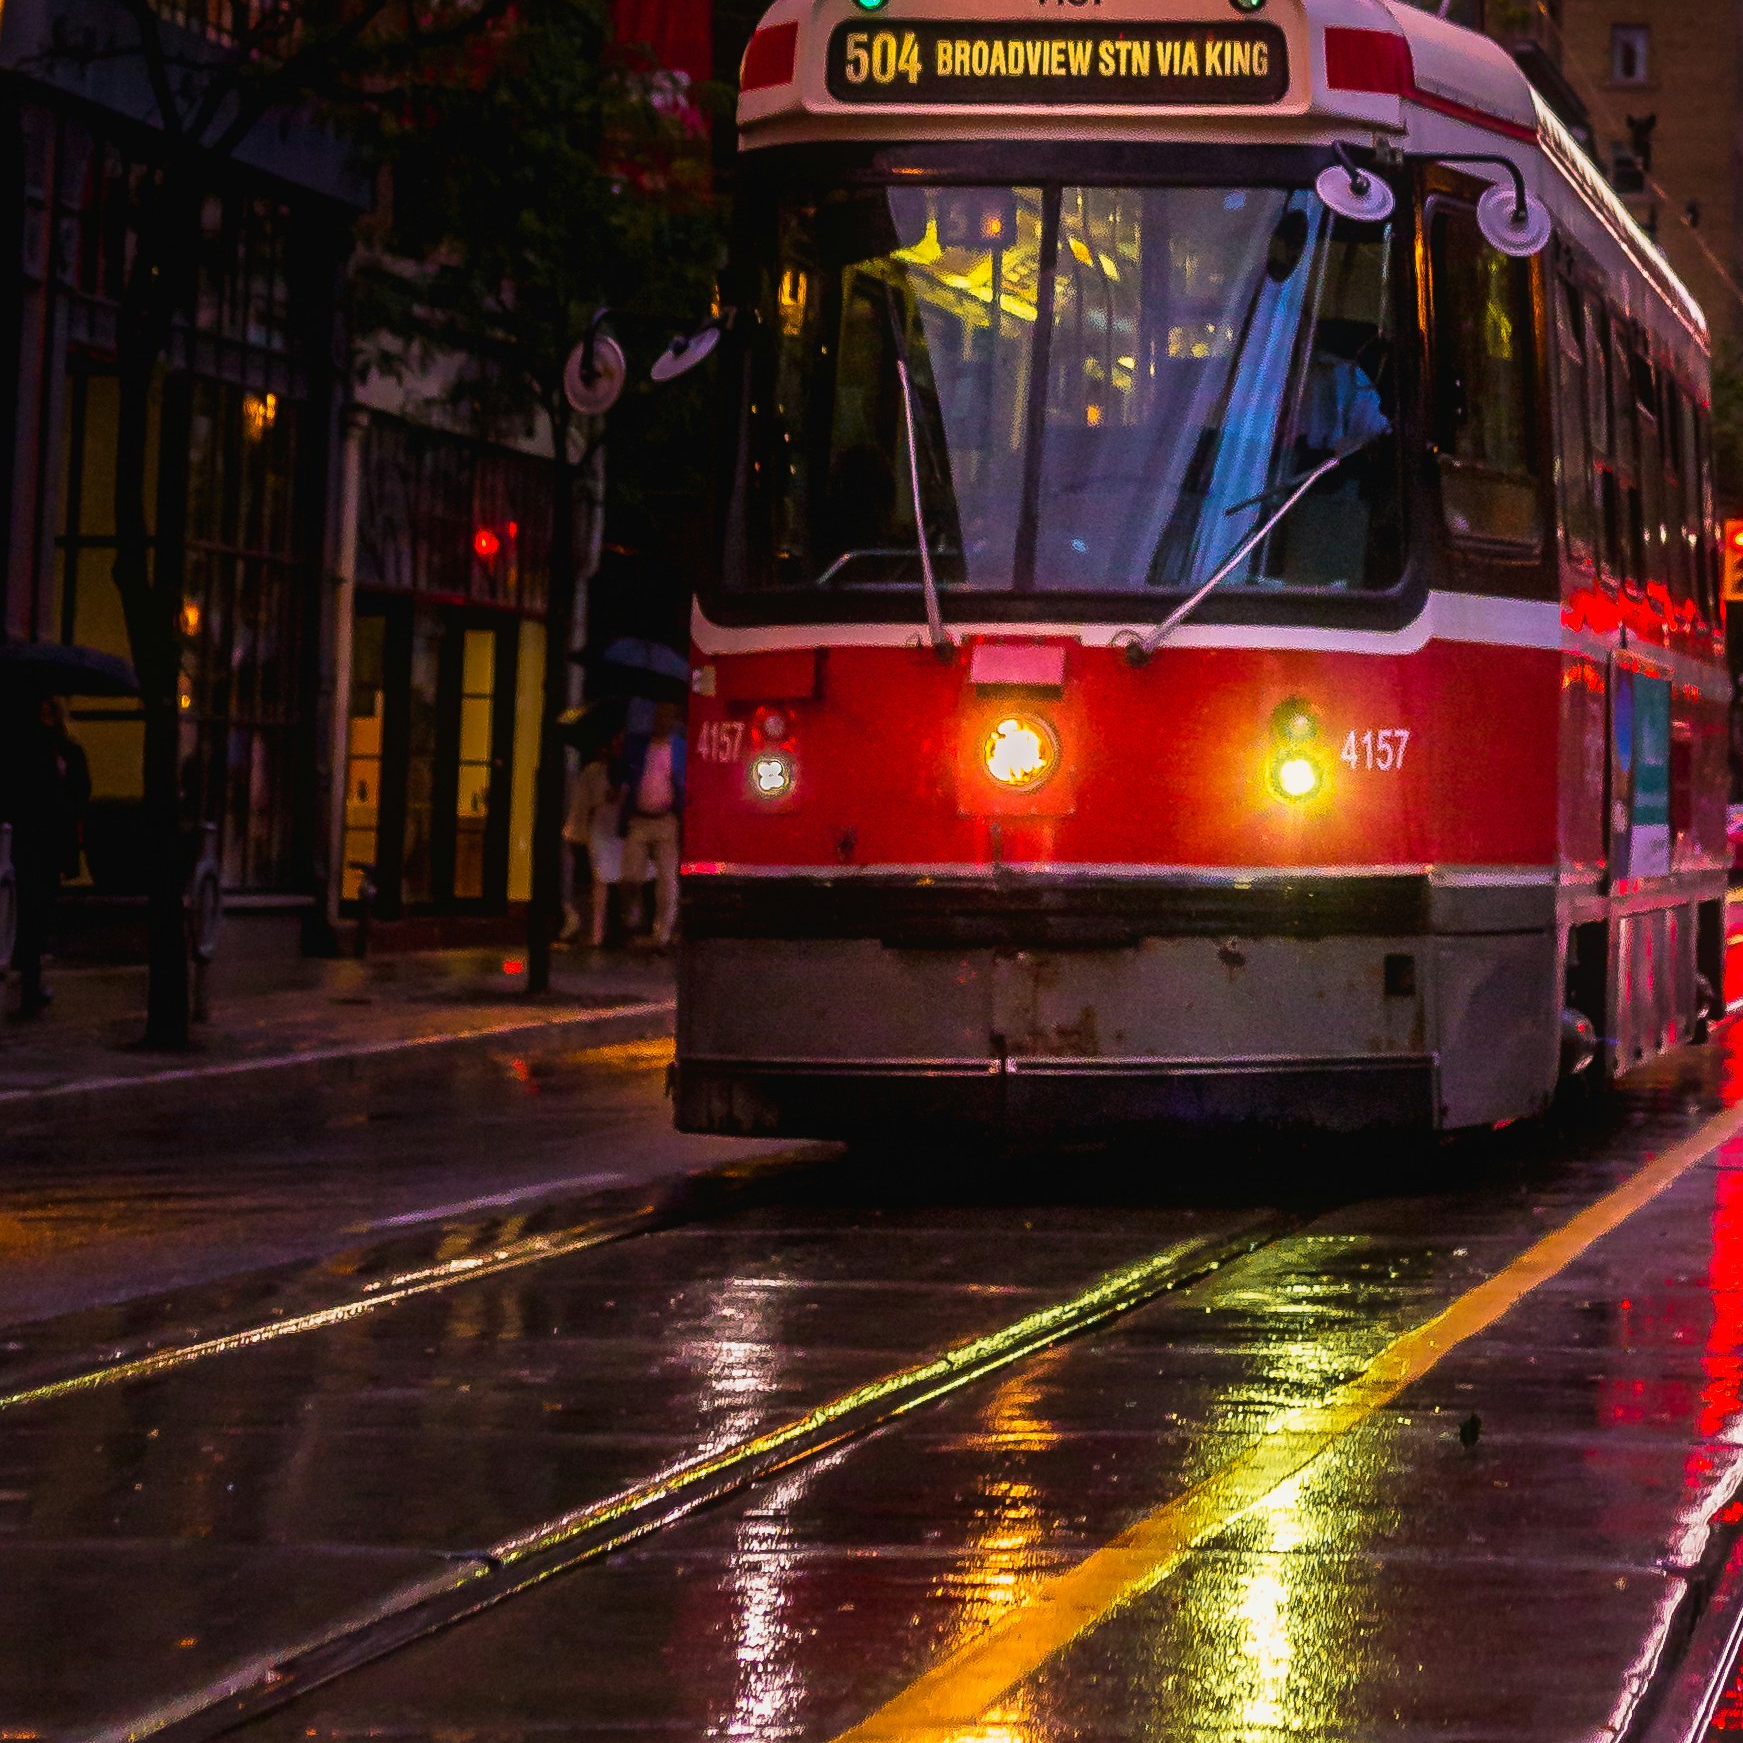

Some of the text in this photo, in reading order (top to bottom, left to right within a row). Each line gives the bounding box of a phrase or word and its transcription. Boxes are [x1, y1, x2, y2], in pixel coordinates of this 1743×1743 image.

[845, 31, 1269, 85] 504 BROADVIEW STN VIA KING
[697, 721, 746, 763] 4157
[1340, 729, 1411, 771] 4157
